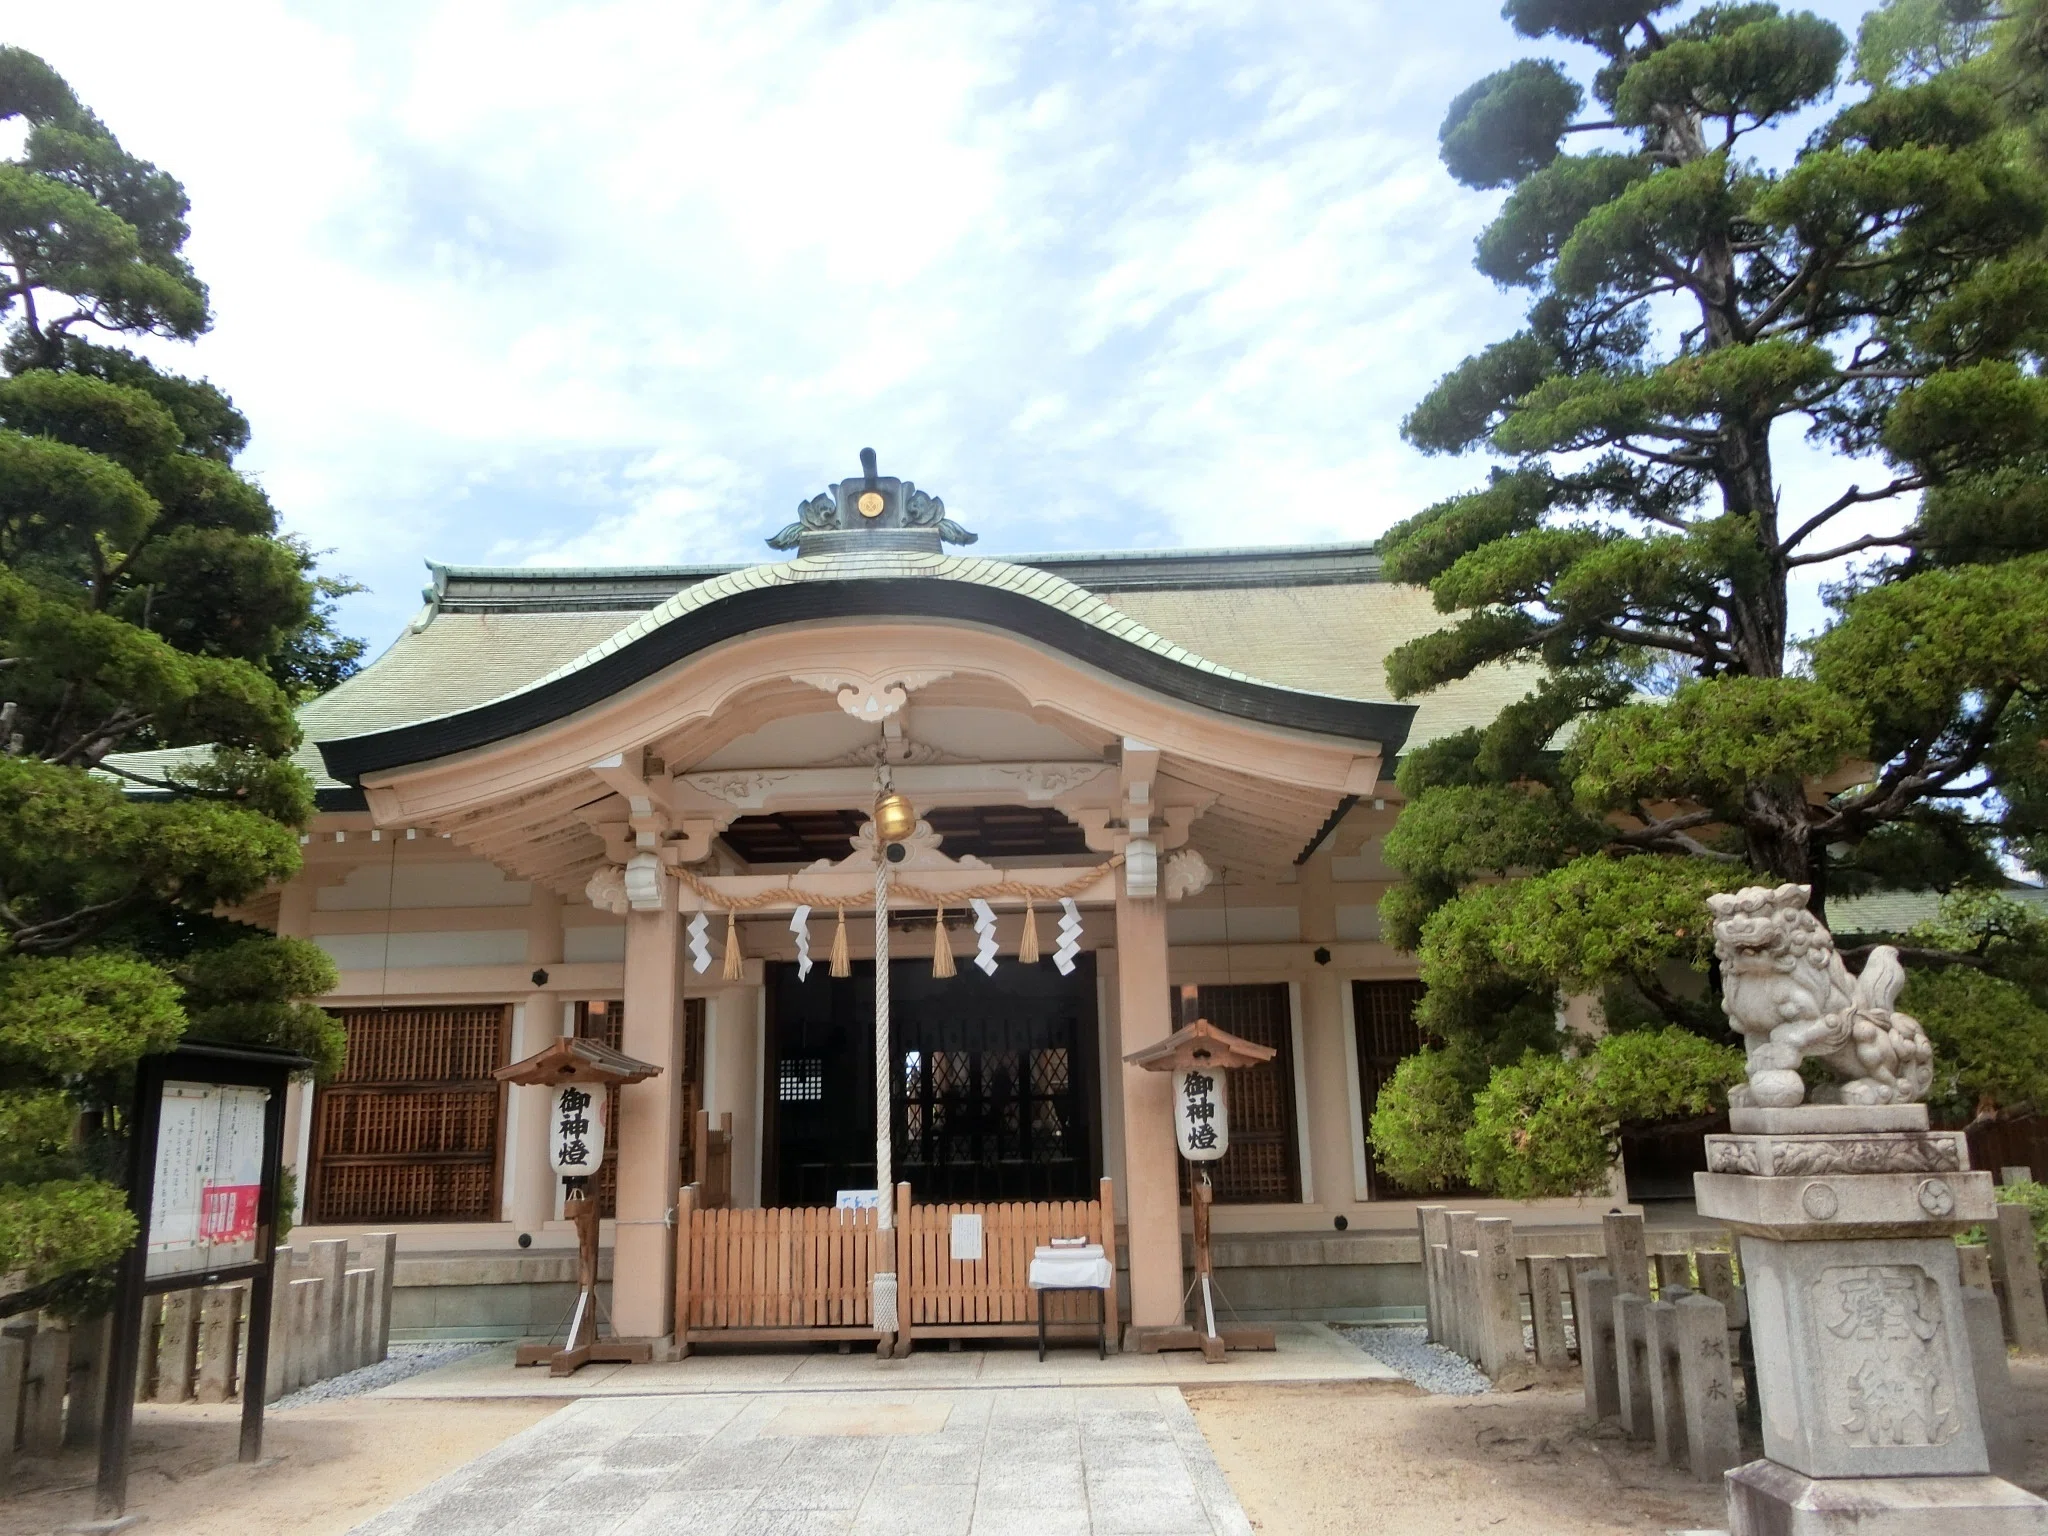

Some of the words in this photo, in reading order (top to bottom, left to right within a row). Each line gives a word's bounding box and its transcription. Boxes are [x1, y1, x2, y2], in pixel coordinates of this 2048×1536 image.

[558, 1086, 592, 1167] 御神燈
[1183, 1070, 1218, 1150] 御神燈
